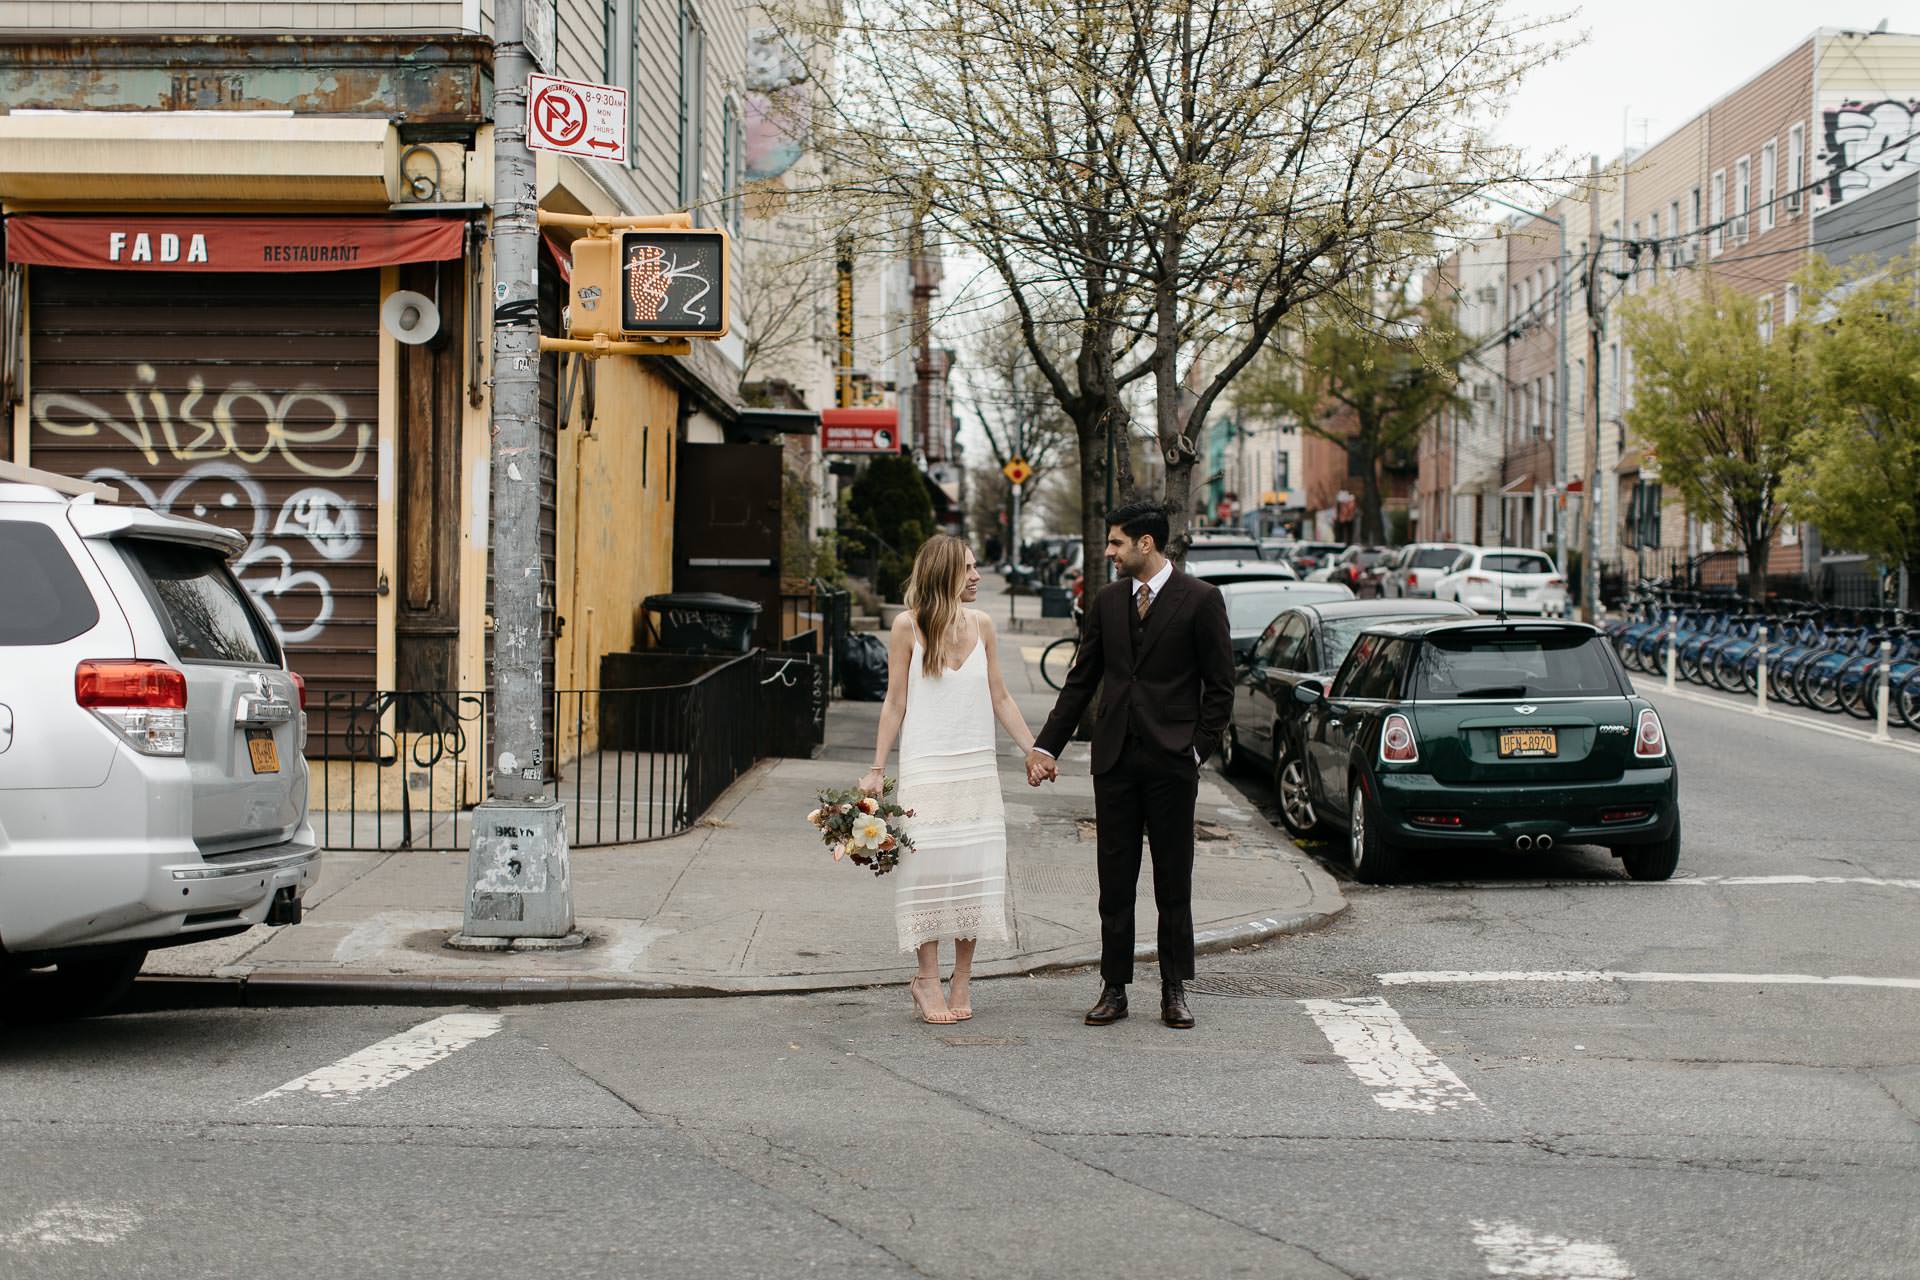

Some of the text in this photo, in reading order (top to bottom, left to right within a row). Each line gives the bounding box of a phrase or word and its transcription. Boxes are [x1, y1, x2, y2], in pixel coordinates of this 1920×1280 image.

[597, 109, 611, 117] MON
[593, 125, 614, 135] THURS
[109, 231, 361, 263] FADA RESTAURANT
